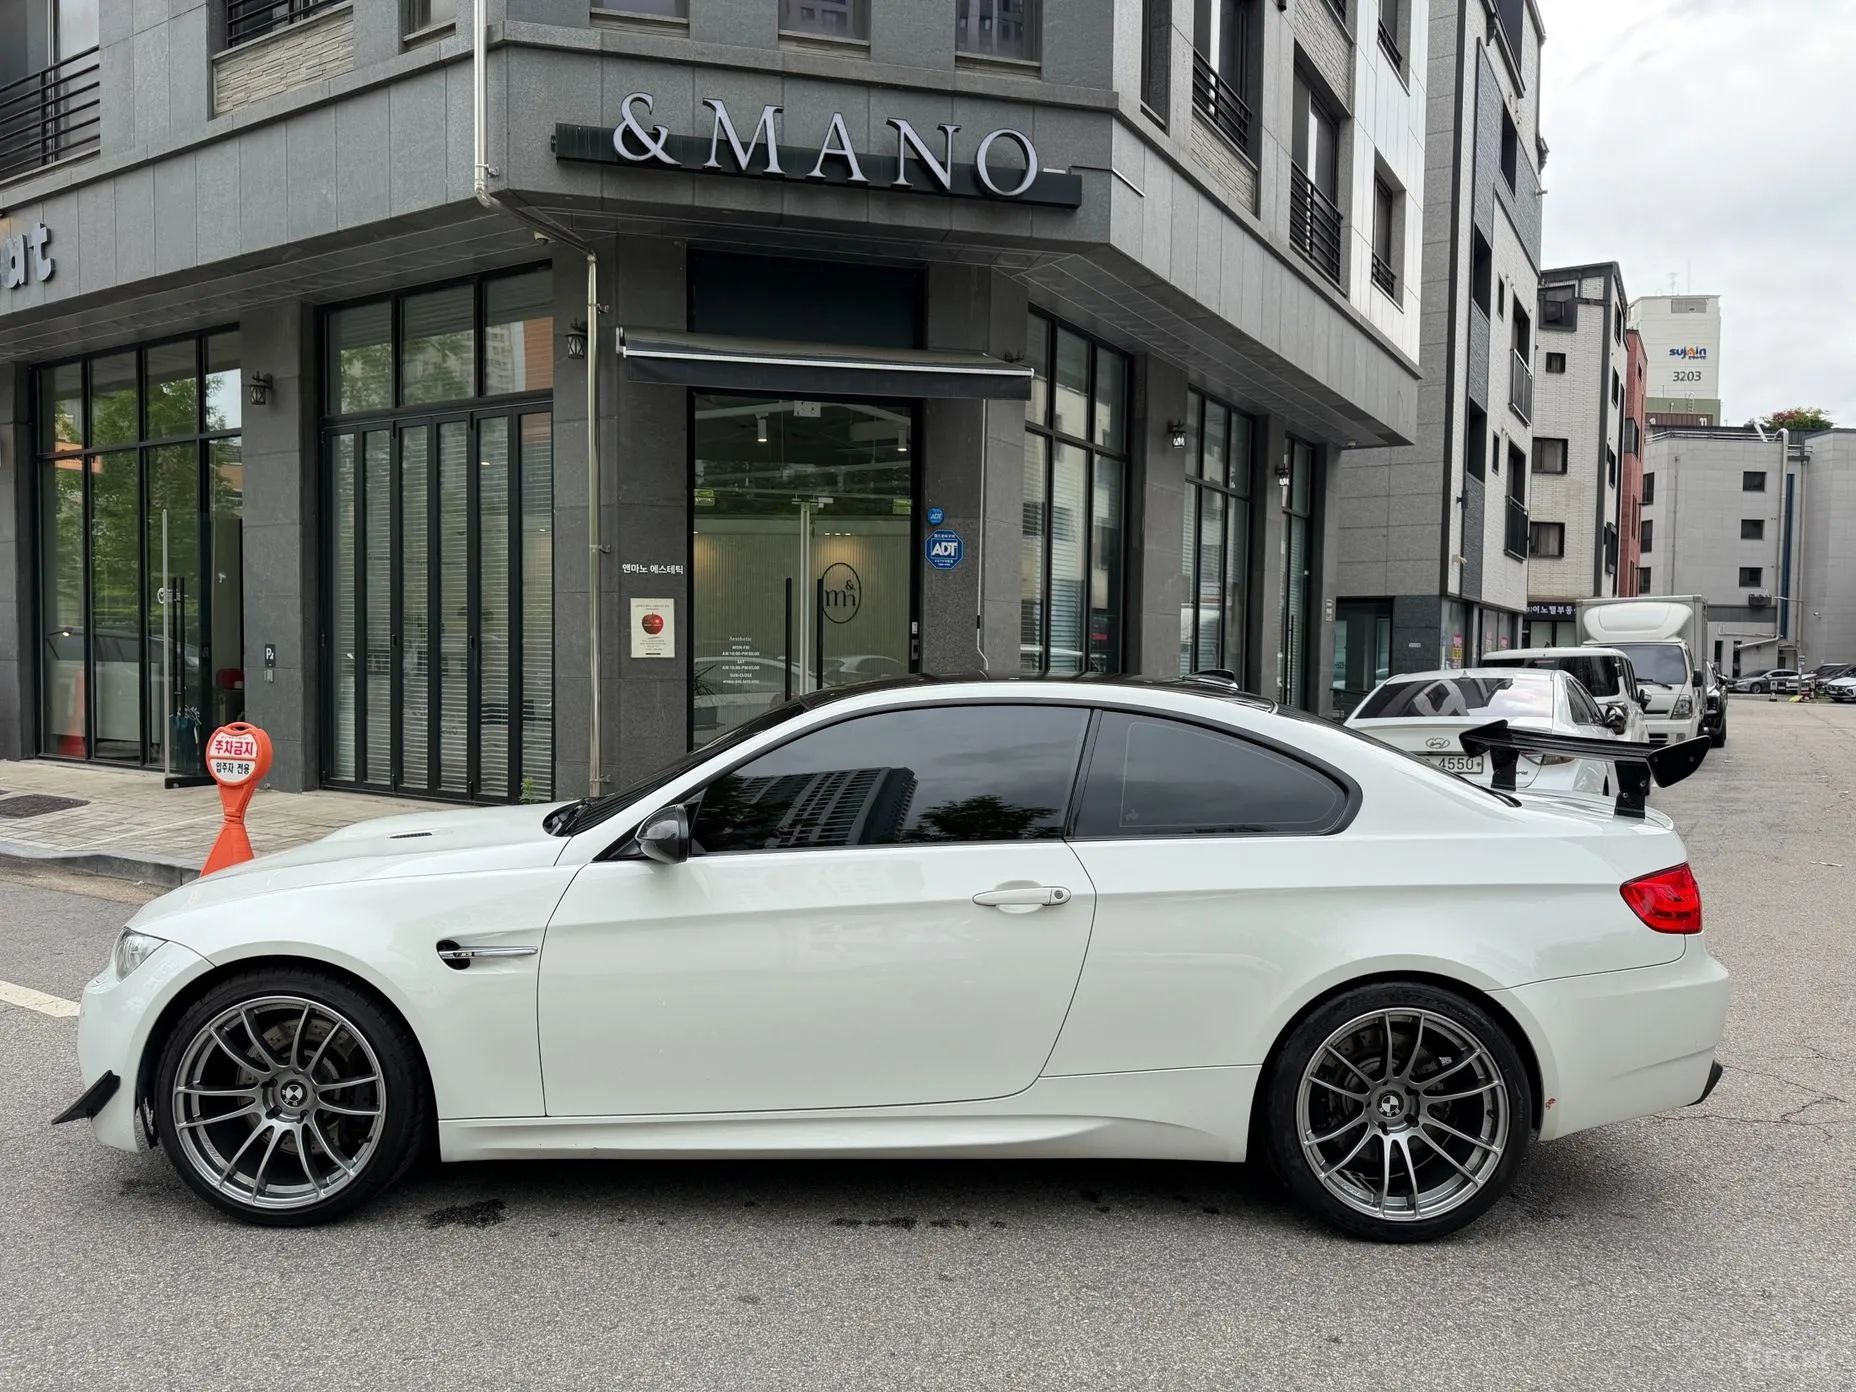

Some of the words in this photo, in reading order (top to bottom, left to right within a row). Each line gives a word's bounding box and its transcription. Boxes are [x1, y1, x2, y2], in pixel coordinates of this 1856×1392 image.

[612, 91, 682, 166] &
[702, 97, 1039, 197] MANO
[1672, 371, 1702, 382] 3203
[931, 541, 958, 556] ADT
[622, 563, 648, 573] 앤마노
[650, 564, 684, 575] 에스테틱
[214, 739, 254, 756] 주차금지
[237, 762, 250, 775] 전용
[1438, 757, 1474, 771] 4550
